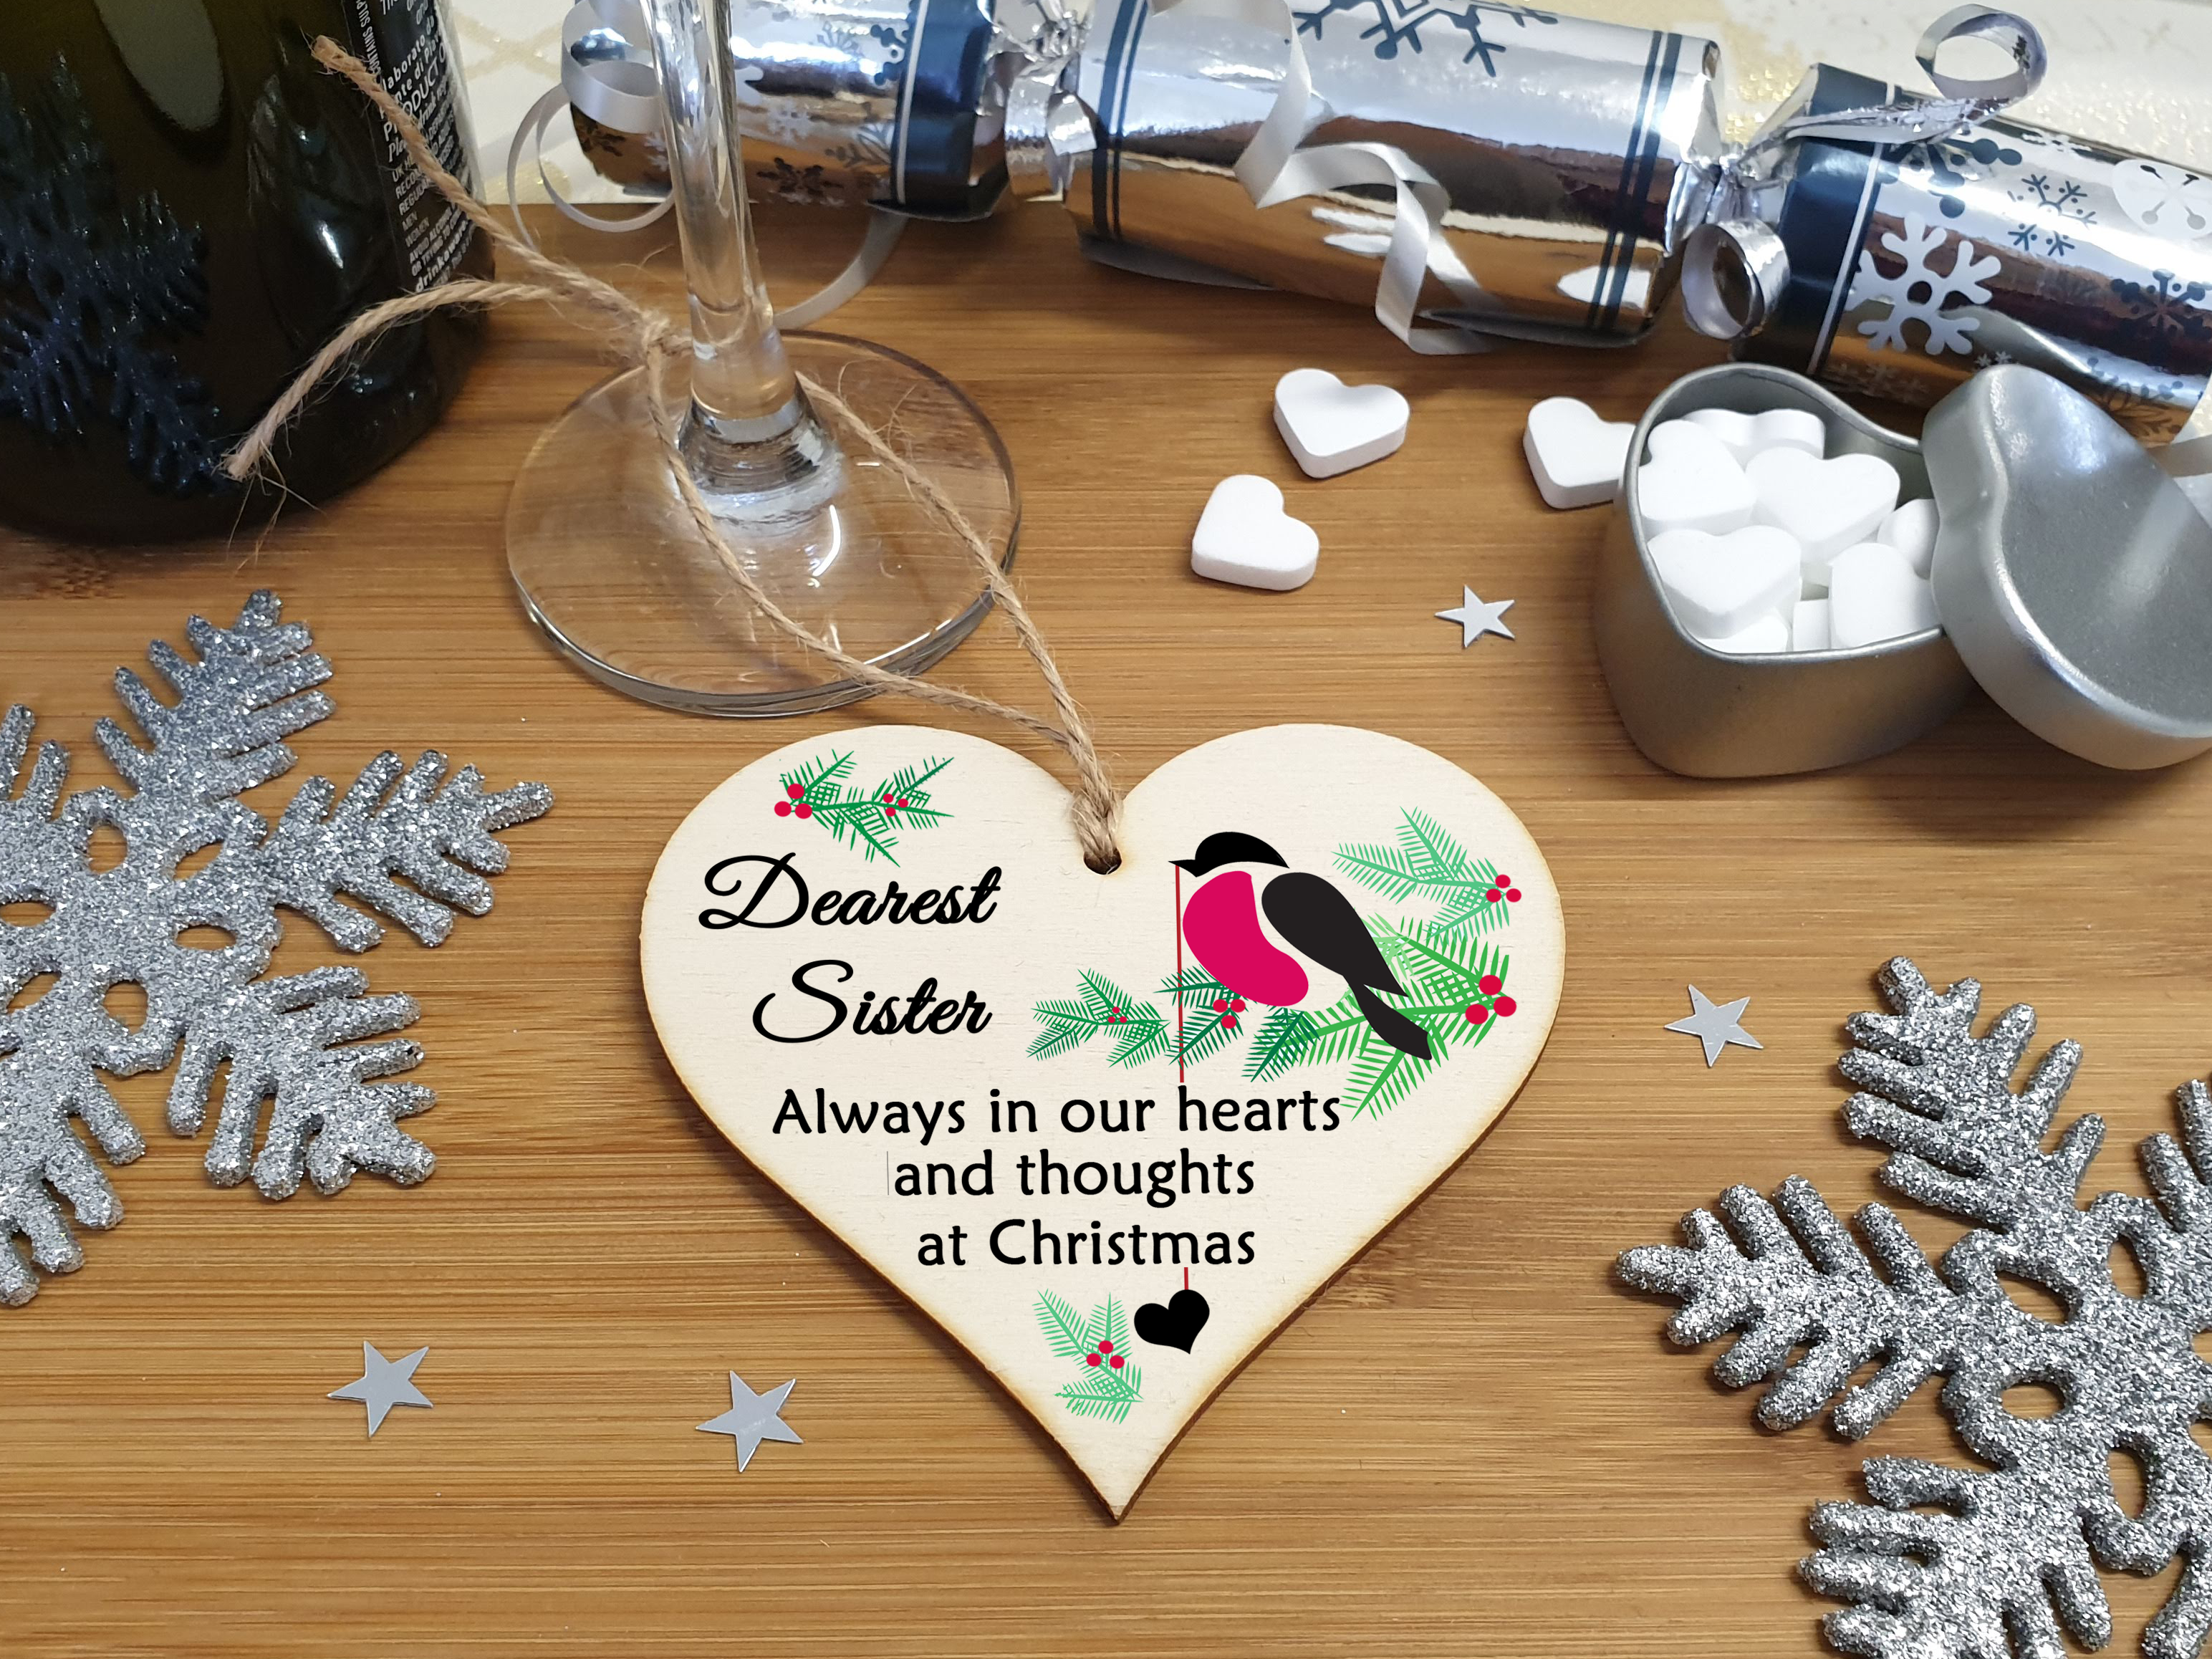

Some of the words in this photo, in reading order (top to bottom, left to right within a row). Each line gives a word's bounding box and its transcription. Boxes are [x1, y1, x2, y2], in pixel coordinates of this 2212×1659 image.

[383, 34, 425, 92] laborato
[383, 56, 438, 142] PODUCT
[699, 852, 1001, 930] Dearest
[753, 959, 993, 1044] Sister
[773, 1088, 965, 1146] Always
[991, 1088, 1038, 1133] in
[1061, 1099, 1155, 1133] our
[1178, 1085, 1340, 1132] hearts
[895, 1149, 994, 1196] and
[1016, 1148, 1254, 1208] thoughts
[918, 1225, 968, 1266] at
[989, 1218, 1255, 1265] Christmas
